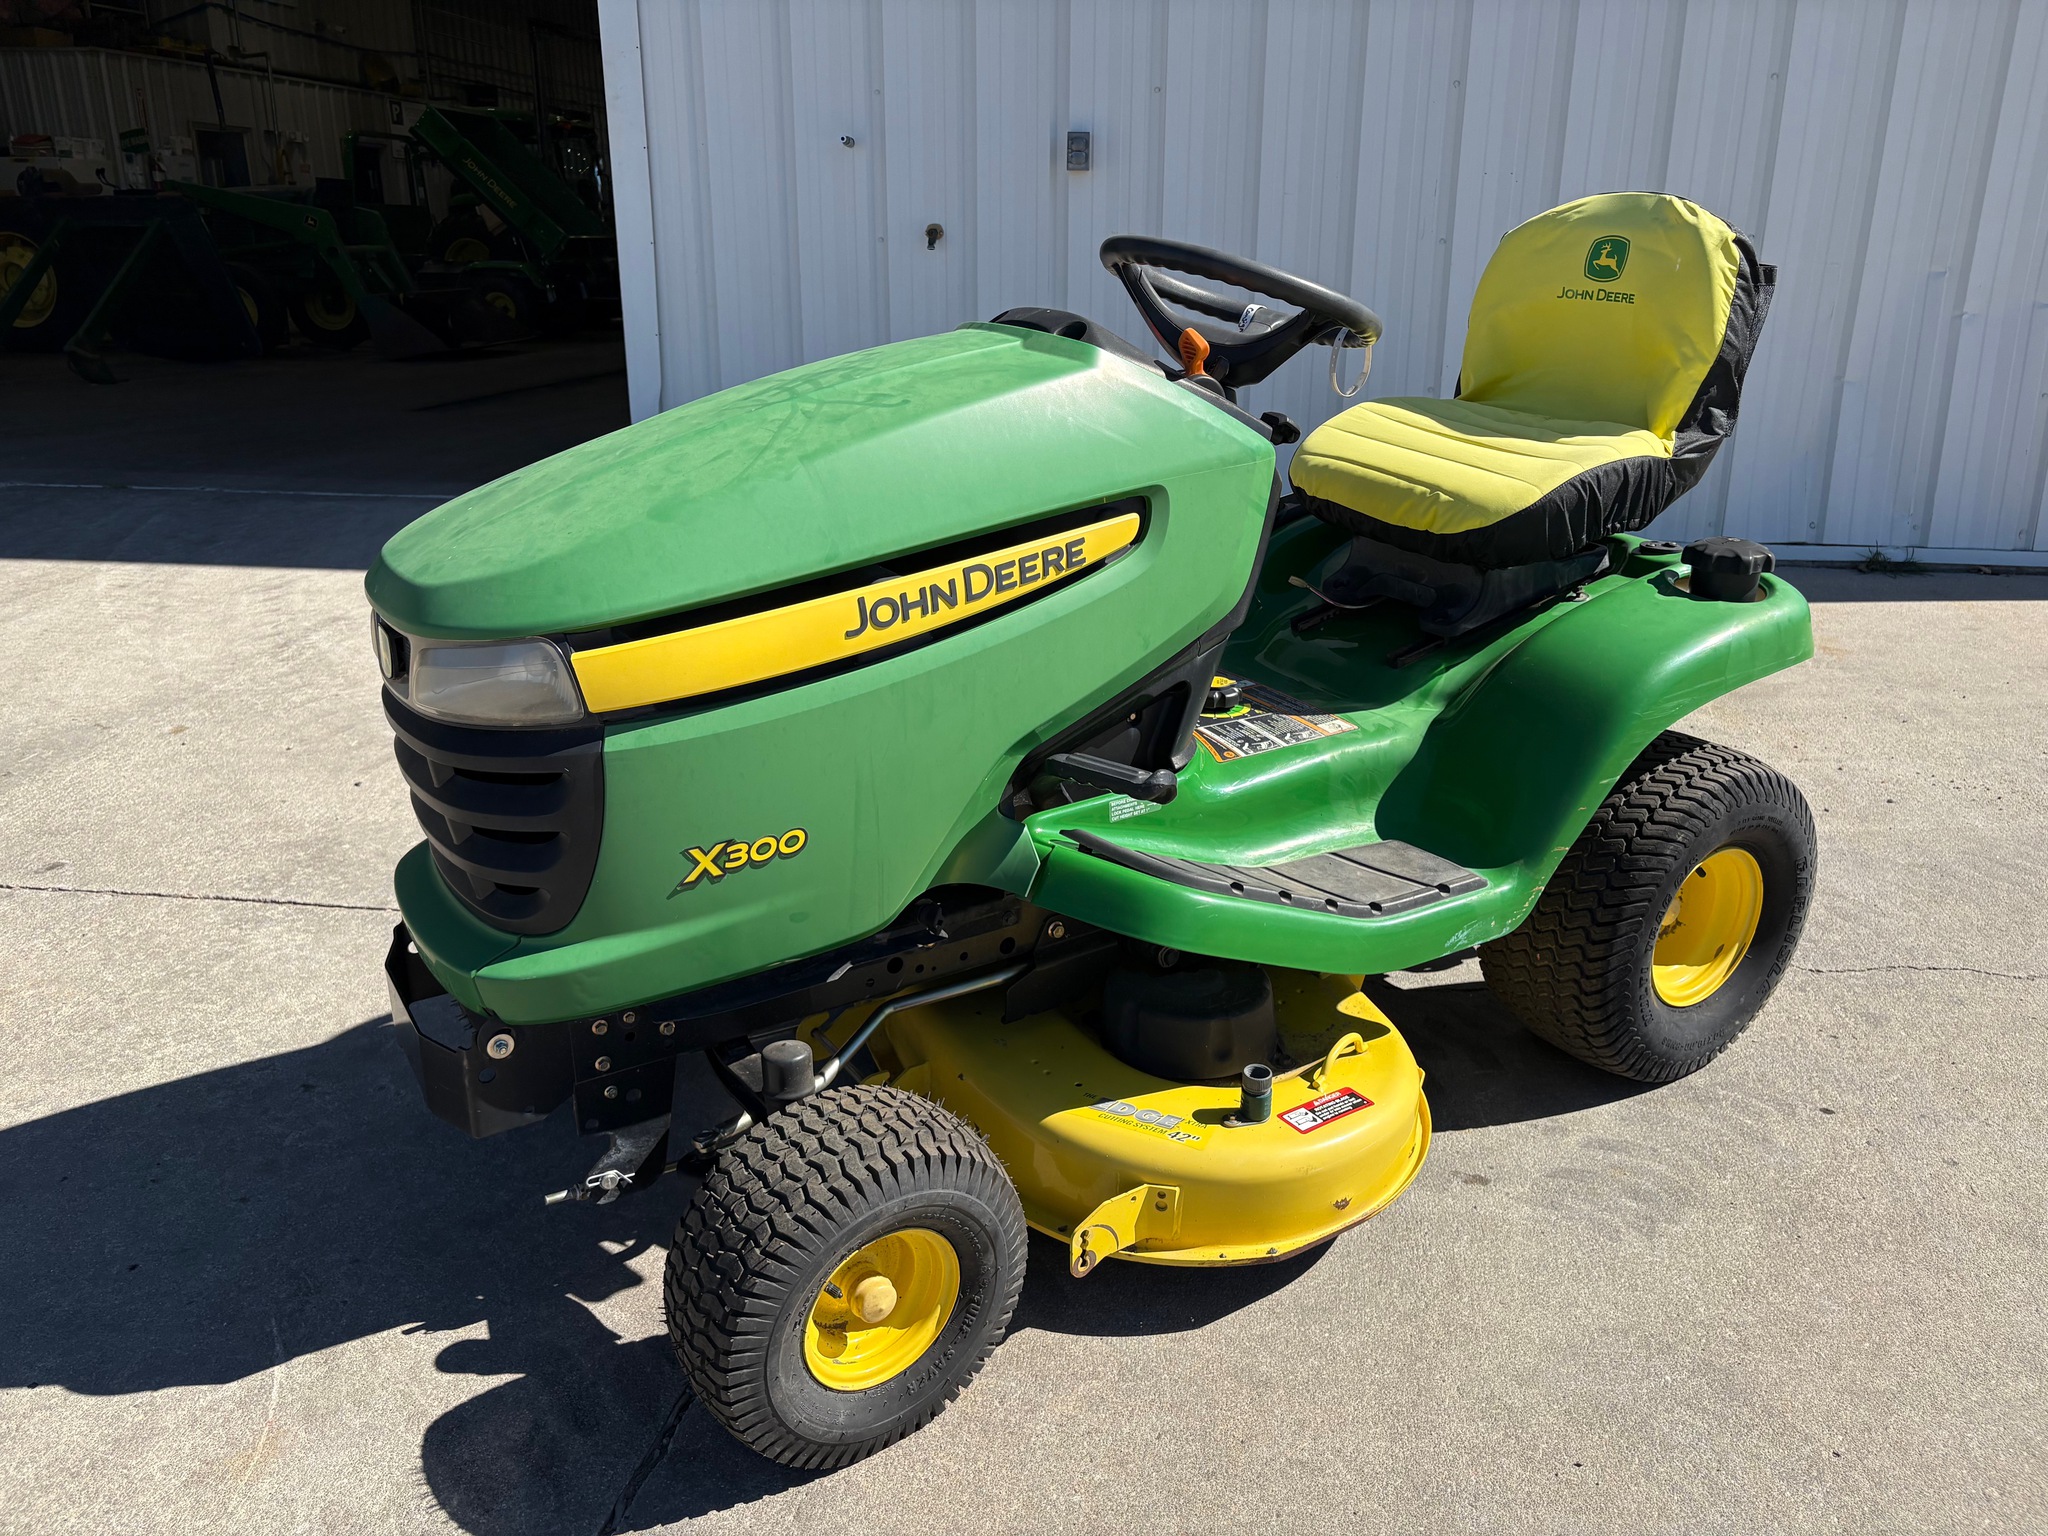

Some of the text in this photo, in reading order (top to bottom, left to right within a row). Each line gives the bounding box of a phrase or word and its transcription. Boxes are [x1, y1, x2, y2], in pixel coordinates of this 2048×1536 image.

[462, 157, 519, 209] JOHN DEERE
[1557, 286, 1635, 304] JOHN DEERE
[844, 537, 1087, 640] JOHN DEERE
[671, 827, 808, 894] X300
[1757, 856, 1808, 998] CARLISLE
[1088, 1097, 1185, 1130] EDGE
[1098, 1112, 1201, 1142] CUTTING SYSTEM 42"
